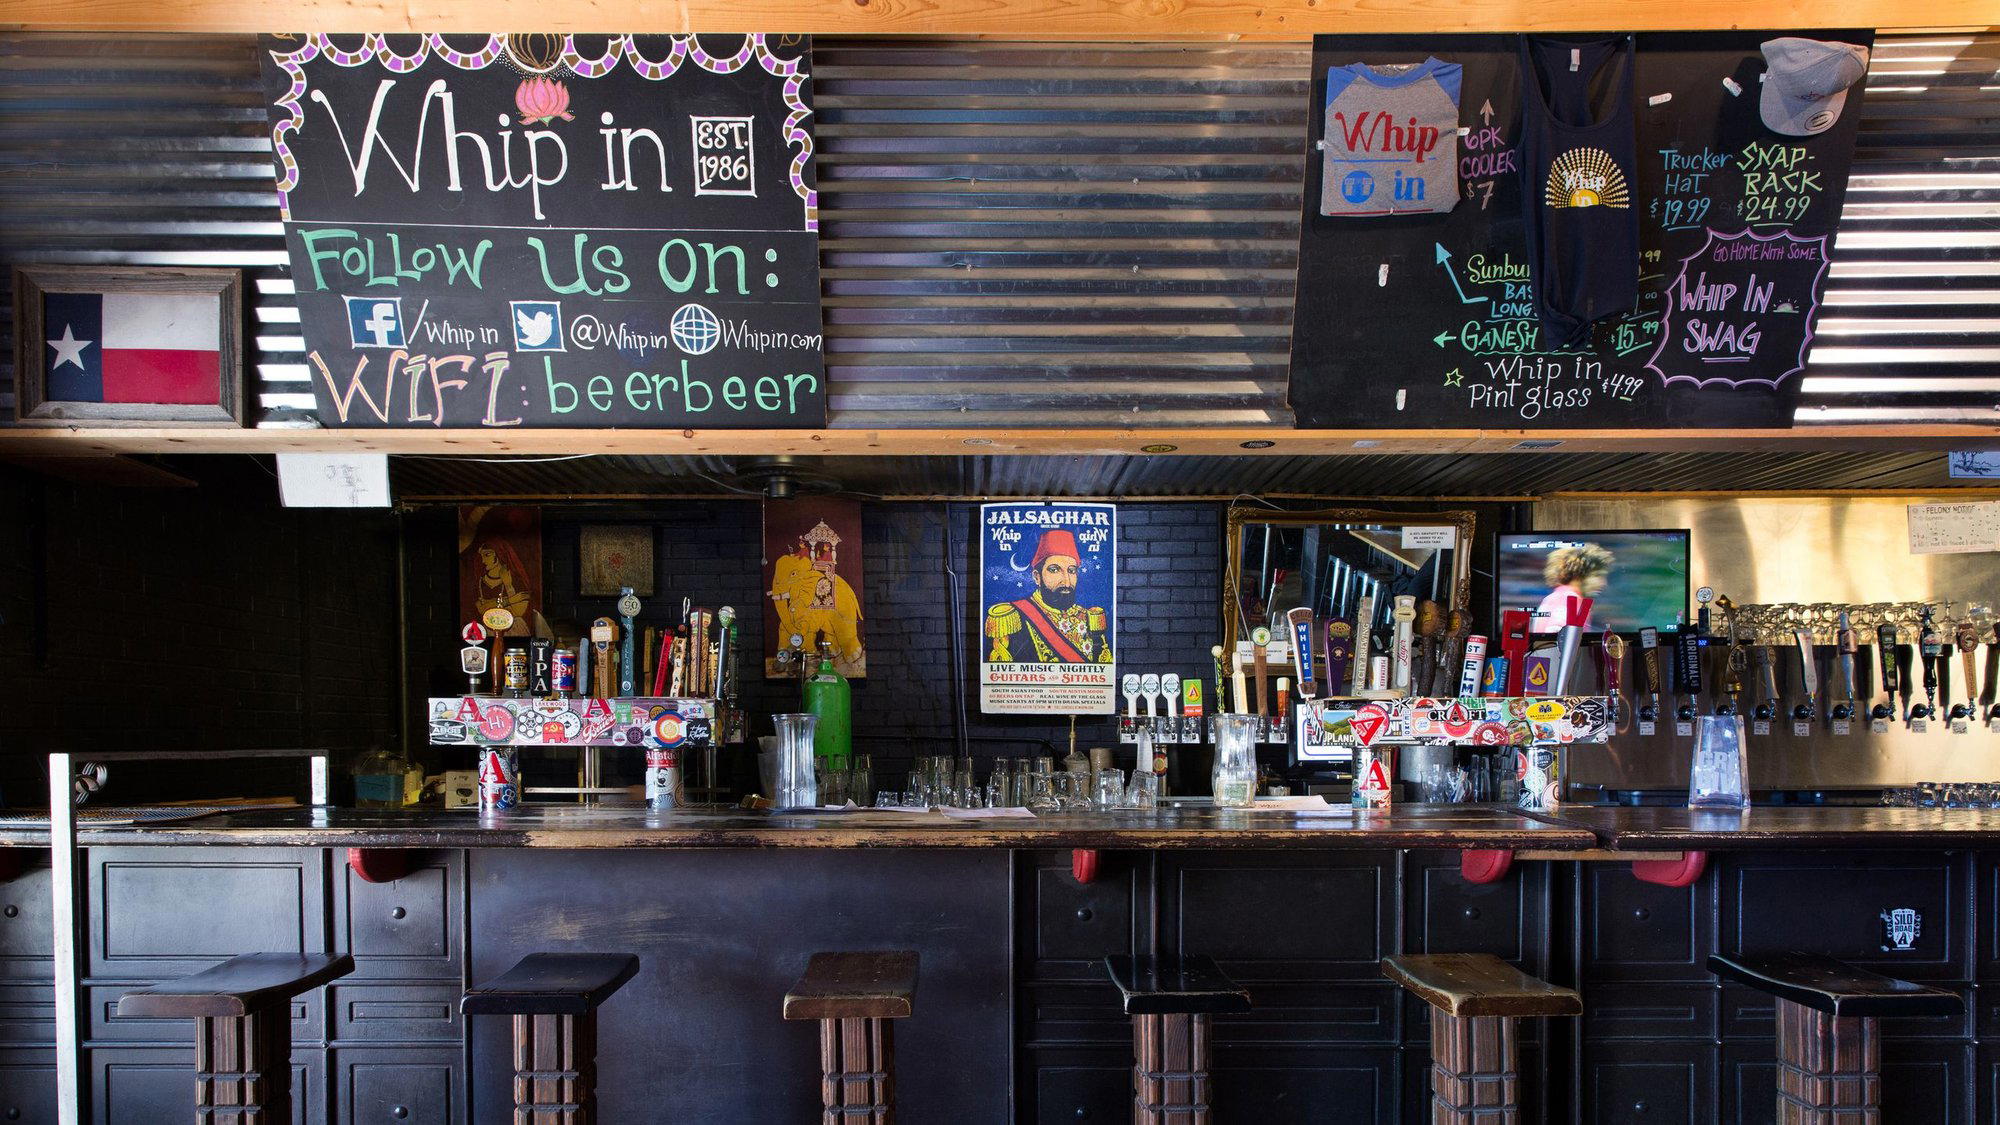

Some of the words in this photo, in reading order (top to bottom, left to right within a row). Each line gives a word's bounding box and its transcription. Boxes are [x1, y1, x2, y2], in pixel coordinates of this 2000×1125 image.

[698, 122, 749, 149] EST.
[1334, 111, 1439, 163] Whip
[1464, 126, 1506, 150] 6PK
[311, 79, 567, 220] Whip
[599, 112, 673, 192] in
[698, 154, 749, 187] 1986
[1460, 149, 1517, 179] COOLER
[1394, 169, 1425, 200] in
[1744, 171, 1823, 195] BACK
[1737, 195, 1811, 221] $24.99
[527, 233, 631, 296] Us
[658, 238, 778, 296] On:
[1713, 244, 1728, 262] GO
[1730, 242, 1760, 261] HOME
[1680, 272, 1737, 311] WHIP
[1743, 274, 1774, 314] IN
[1461, 321, 1539, 351] GANESH
[1683, 319, 1761, 355] SWAG
[1484, 355, 1562, 388] Whip
[1575, 357, 1602, 380] in
[544, 356, 818, 414] beerbeer
[1468, 379, 1522, 408] Pint
[1520, 385, 1592, 419] glass
[987, 511, 1110, 526] JALSAGHAR
[1926, 506, 1952, 514] FELONY
[991, 527, 1022, 545] Whip
[999, 541, 1012, 551] in
[1297, 624, 1310, 670] WHITE
[1467, 645, 1480, 653] ST
[990, 672, 1046, 682] GUITARS
[1061, 673, 1106, 683] SITARS
[1020, 665, 1056, 673] MUSIC
[1059, 665, 1106, 673] NIGHTLY
[489, 715, 505, 730] Hi
[1428, 701, 1485, 722] CRAFT
[1894, 914, 1913, 925] SILO
